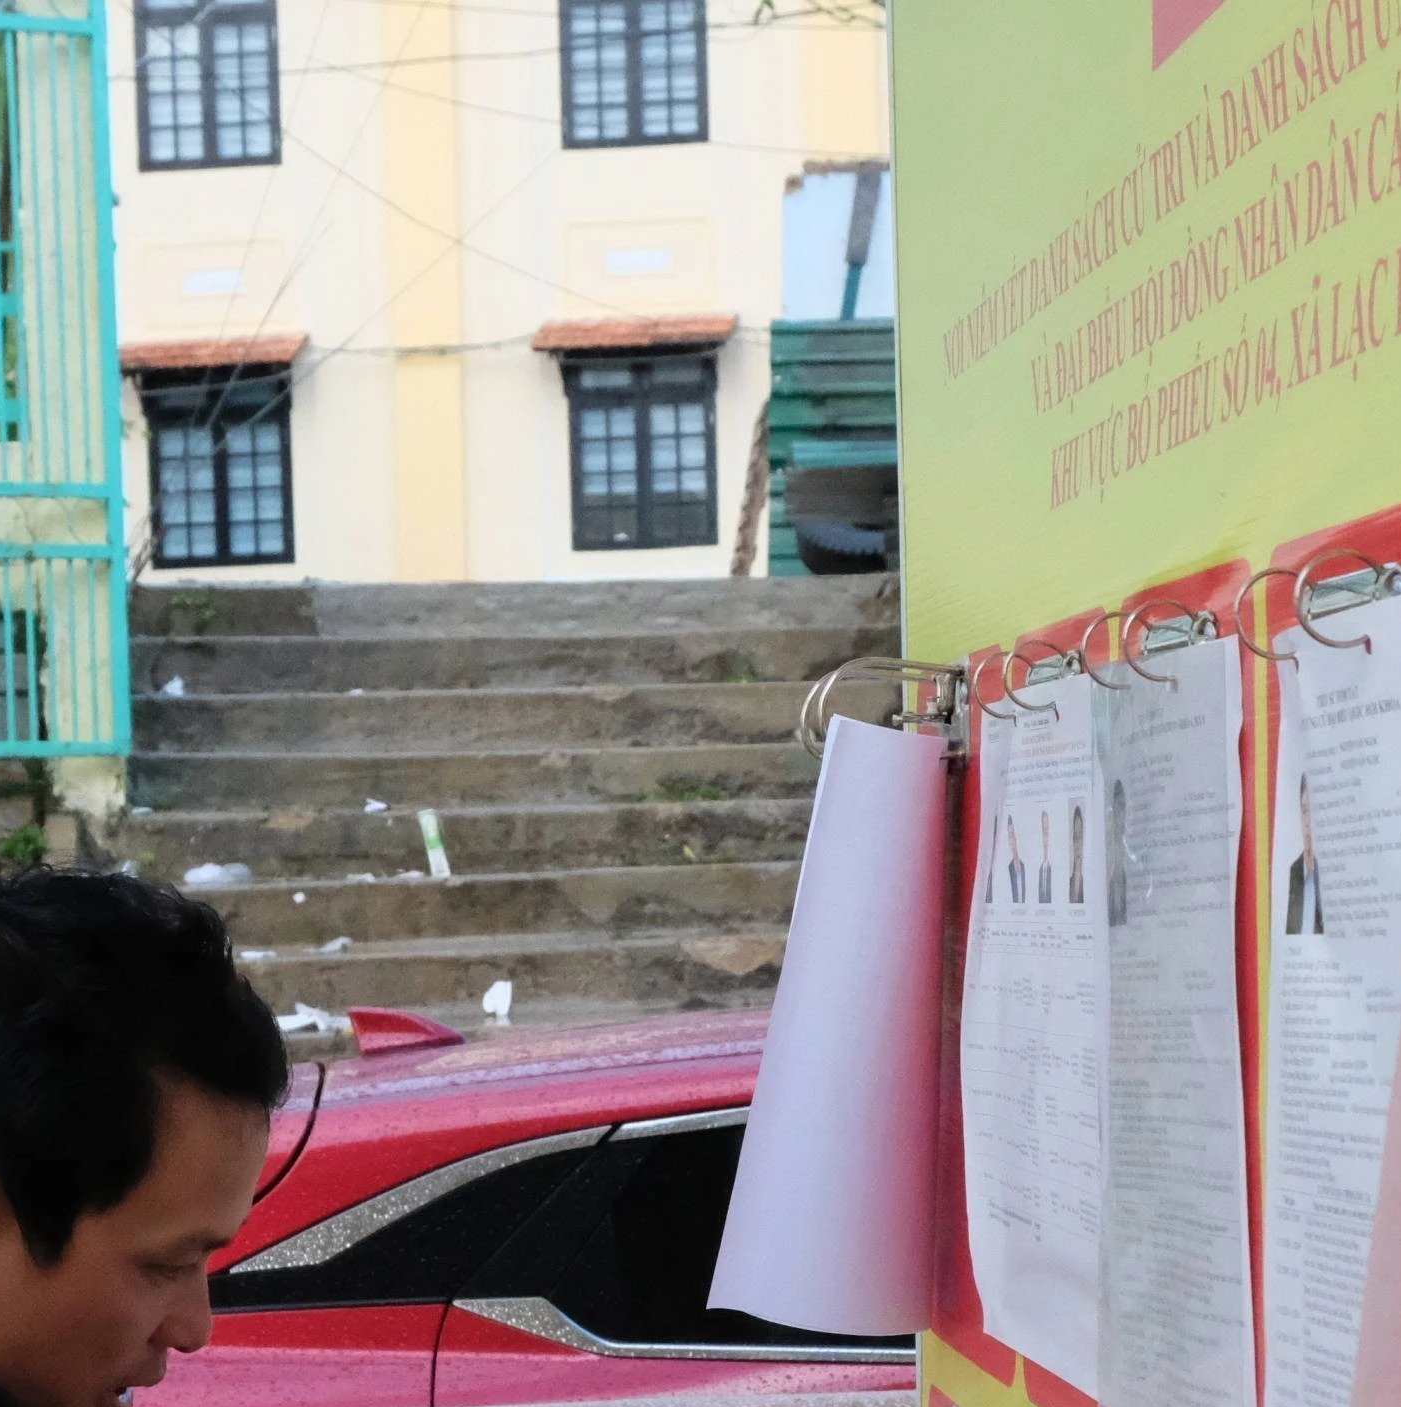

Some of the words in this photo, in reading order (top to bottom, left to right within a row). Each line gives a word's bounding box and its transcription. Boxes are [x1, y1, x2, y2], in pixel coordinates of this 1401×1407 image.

[1029, 227, 1070, 319] DANH
[1073, 186, 1118, 284] SÁCH
[1149, 130, 1186, 222] TRI
[1186, 84, 1220, 193] VÀ
[1220, 41, 1290, 170] DANH
[1293, 0, 1368, 112] SÁCH
[1131, 264, 1166, 367] HỘI
[1233, 163, 1300, 293] NHÂN
[1305, 118, 1362, 247] DÂN
[1050, 431, 1086, 511] KHU
[1155, 340, 1219, 458] PHIẾU
[1221, 312, 1249, 425] SỐ
[1254, 315, 1283, 417] 04,
[1329, 255, 1389, 384] LẠC
